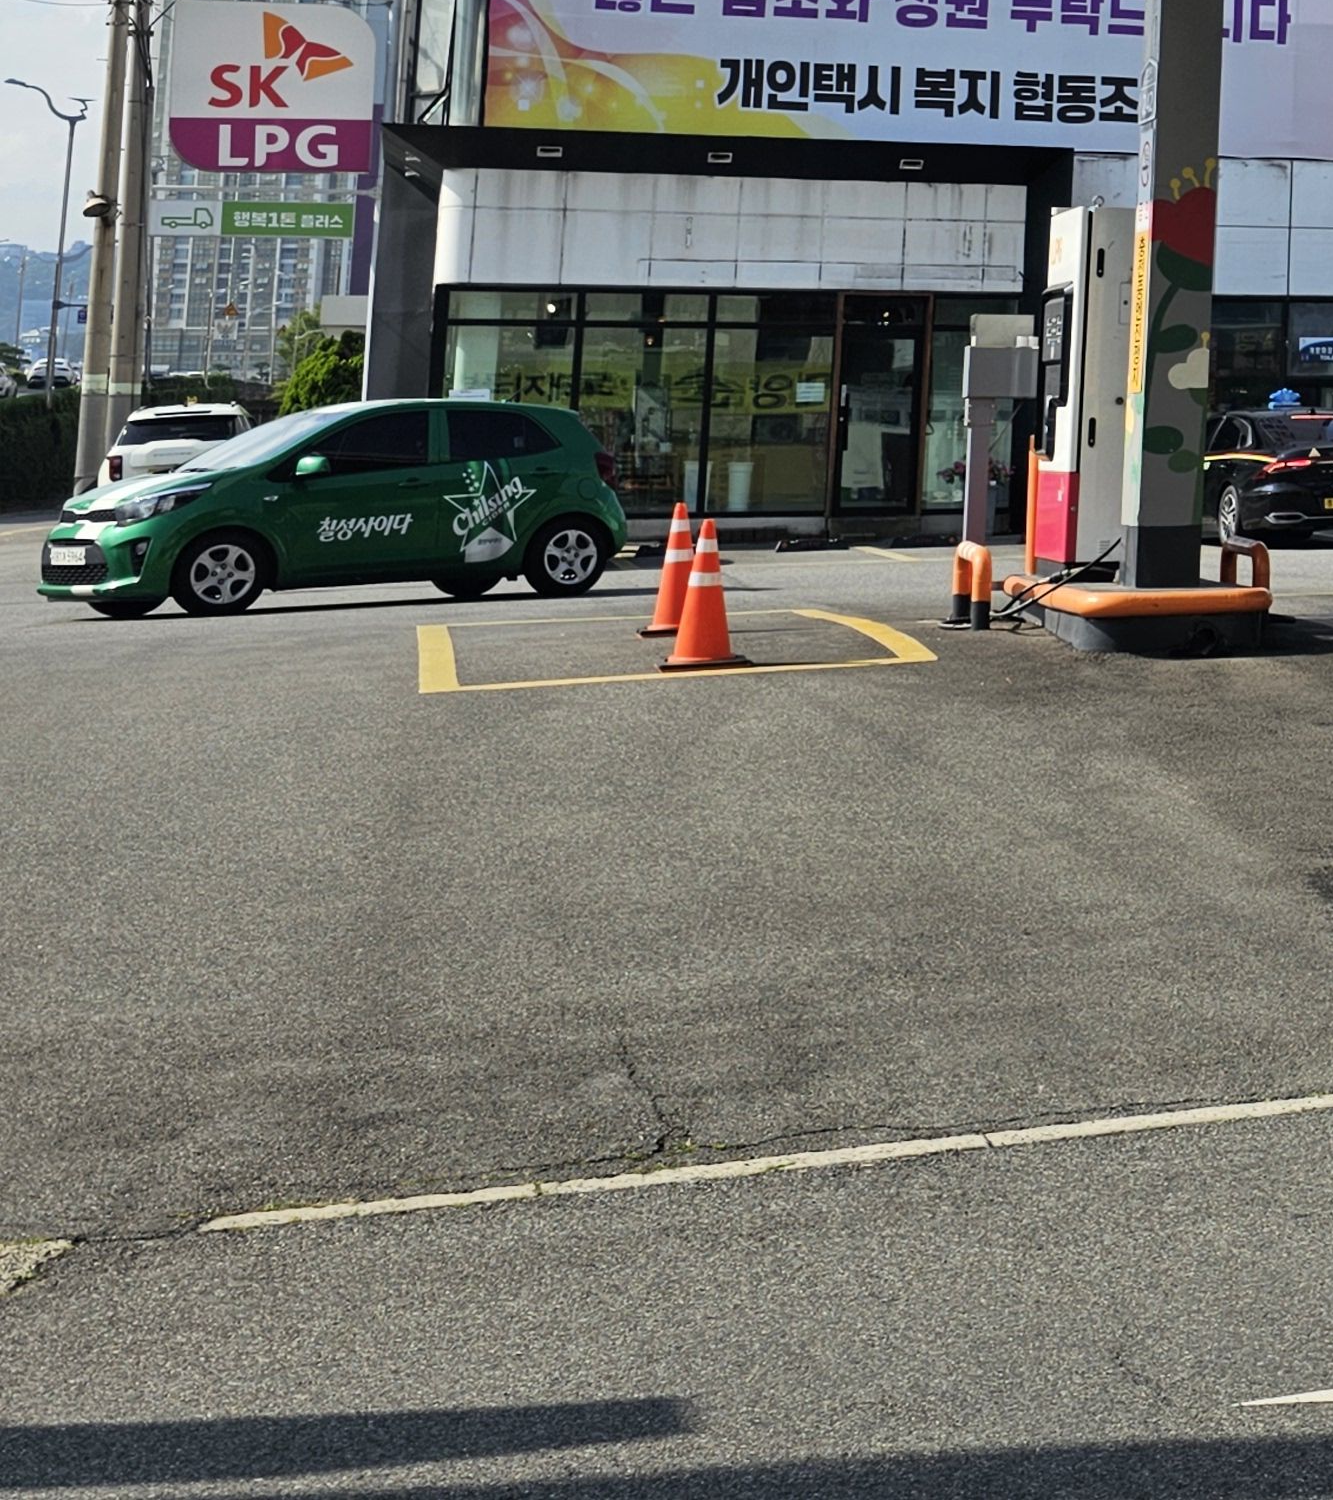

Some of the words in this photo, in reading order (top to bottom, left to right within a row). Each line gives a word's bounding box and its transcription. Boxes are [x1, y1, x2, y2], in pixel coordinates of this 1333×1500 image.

[208, 64, 289, 108] SK
[717, 58, 901, 116] 개인택시
[914, 68, 1000, 119] 복지
[1013, 71, 1139, 123] 협동조
[218, 124, 339, 168] LPG
[234, 211, 296, 228] 행복1톤
[301, 214, 343, 228] 플러스
[318, 513, 413, 542] 칠성사이다
[452, 476, 527, 536] Chilsung
